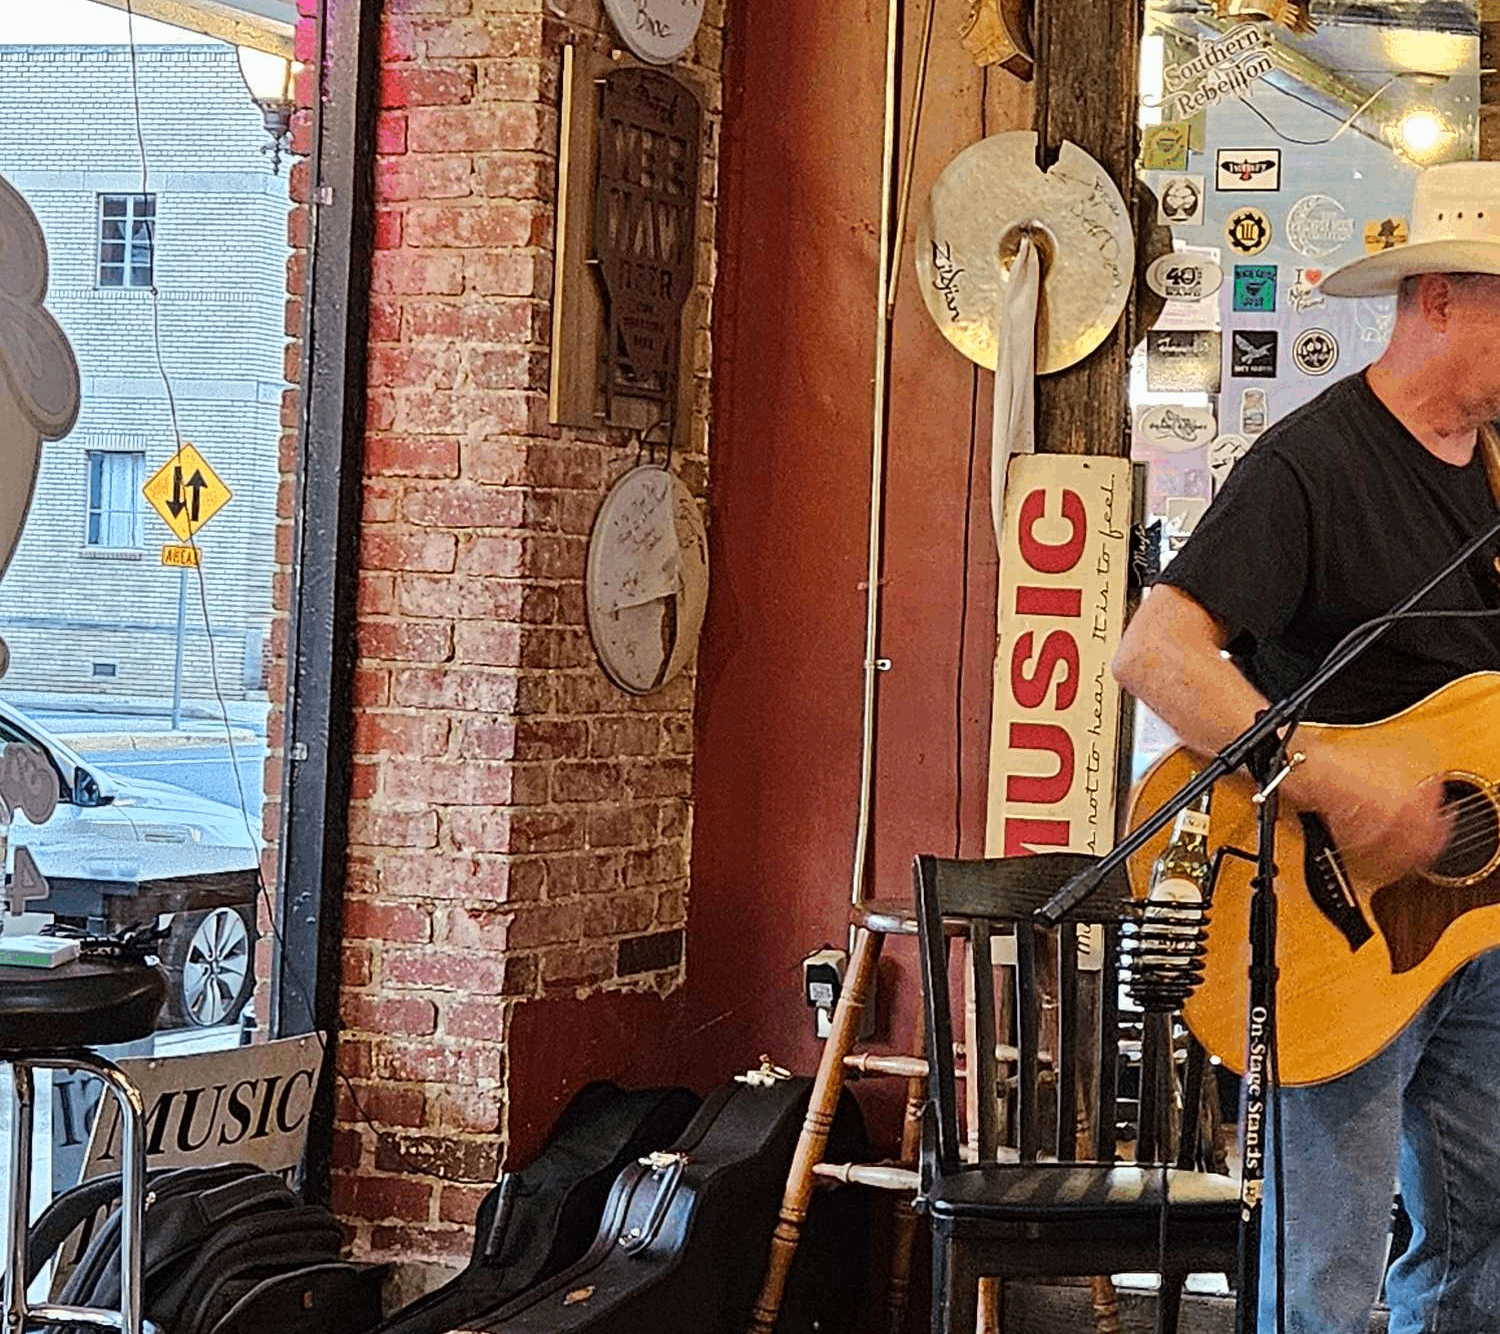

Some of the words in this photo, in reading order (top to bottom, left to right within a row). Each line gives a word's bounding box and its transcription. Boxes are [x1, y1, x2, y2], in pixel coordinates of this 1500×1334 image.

[1164, 29, 1261, 86] Southern
[1177, 56, 1273, 116] Rebellion
[1087, 749, 1101, 774] to
[1086, 778, 1099, 824] not
[1249, 1006, 1268, 1097] On-Stage
[96, 1067, 316, 1161] MUSIC
[1246, 1102, 1264, 1170] Stands
